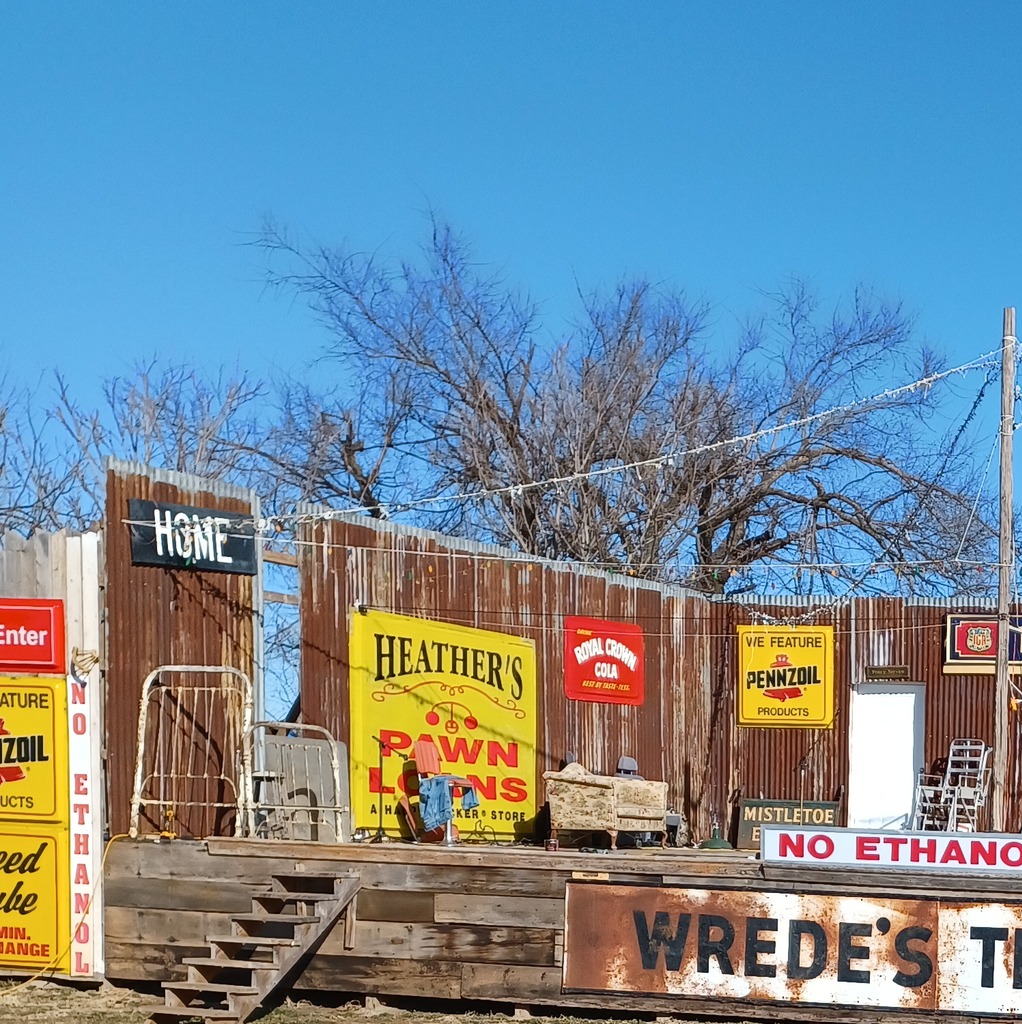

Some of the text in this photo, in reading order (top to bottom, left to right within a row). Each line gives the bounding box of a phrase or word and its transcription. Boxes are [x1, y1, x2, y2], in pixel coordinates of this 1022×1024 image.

[153, 508, 233, 564] HOME
[573, 637, 637, 672] ROYAL CROWN
[746, 636, 823, 648] WE FEATURE
[374, 633, 523, 701] HEATHER'S
[594, 661, 618, 679] COLA
[746, 665, 821, 690] PENNZOIL
[757, 707, 809, 717] PRODUCTS
[0, 735, 49, 765] ZOIL
[368, 766, 528, 803] LONS
[491, 811, 526, 822] STORE
[744, 806, 834, 824] MISTLETOE
[778, 833, 835, 859] NO
[73, 773, 91, 973] ETHANOL
[0, 941, 50, 957] ANGE
[632, 909, 933, 988] WREDE'S
